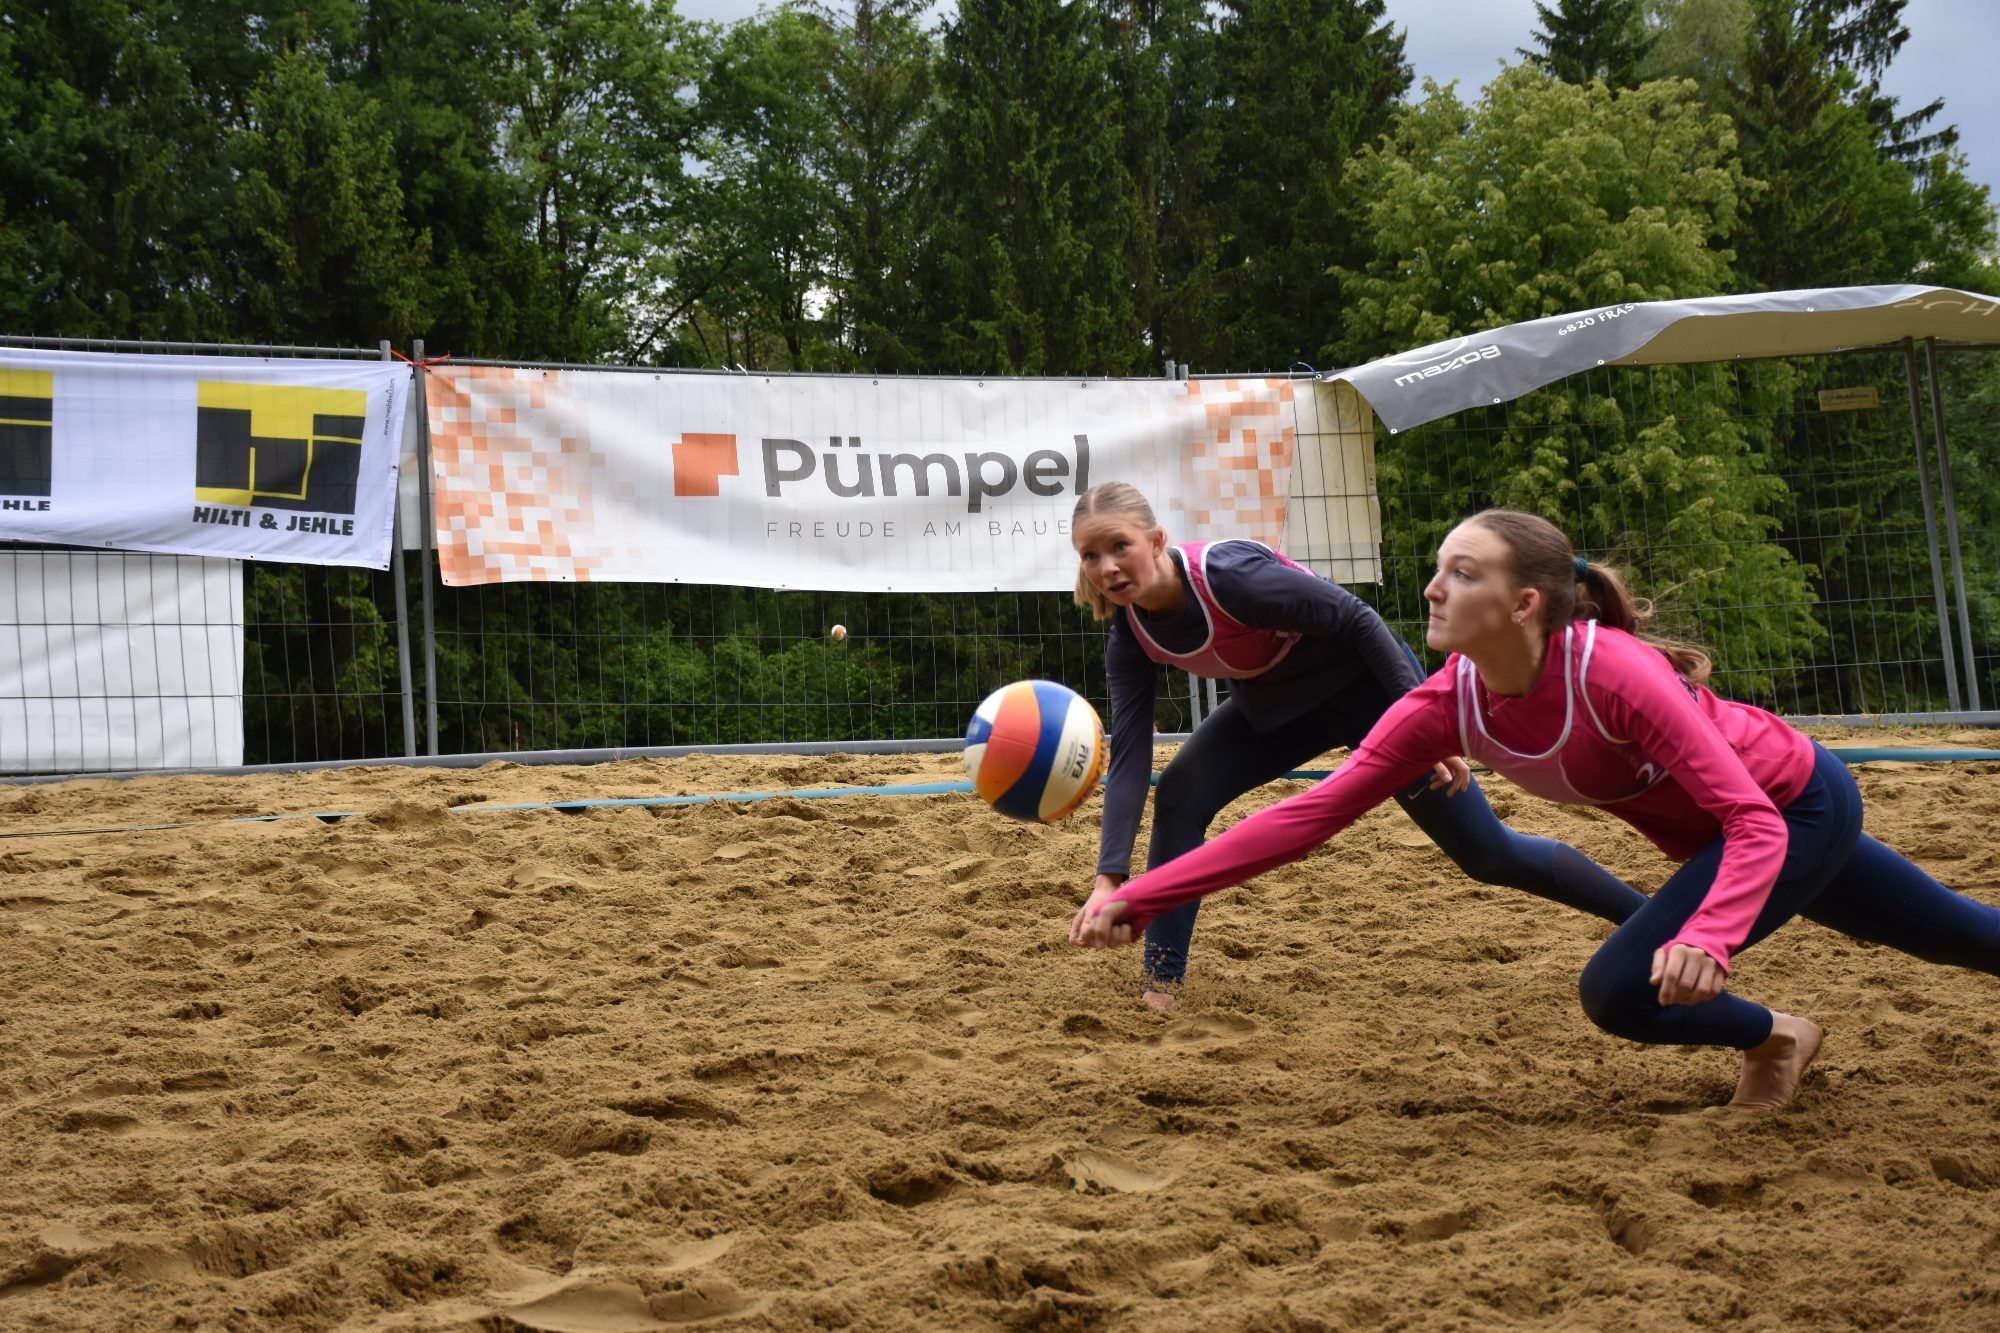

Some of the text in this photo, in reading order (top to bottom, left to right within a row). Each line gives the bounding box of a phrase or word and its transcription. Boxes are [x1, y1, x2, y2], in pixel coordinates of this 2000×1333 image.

[1558, 302, 1641, 336] 6820 FRAS
[1394, 344, 1502, 387] mazda
[761, 434, 1090, 513] Pümpel
[0, 499, 51, 511] HLE
[192, 506, 354, 536] HILTI & JEHLE
[766, 519, 1070, 538] FREUDE AM BAUE
